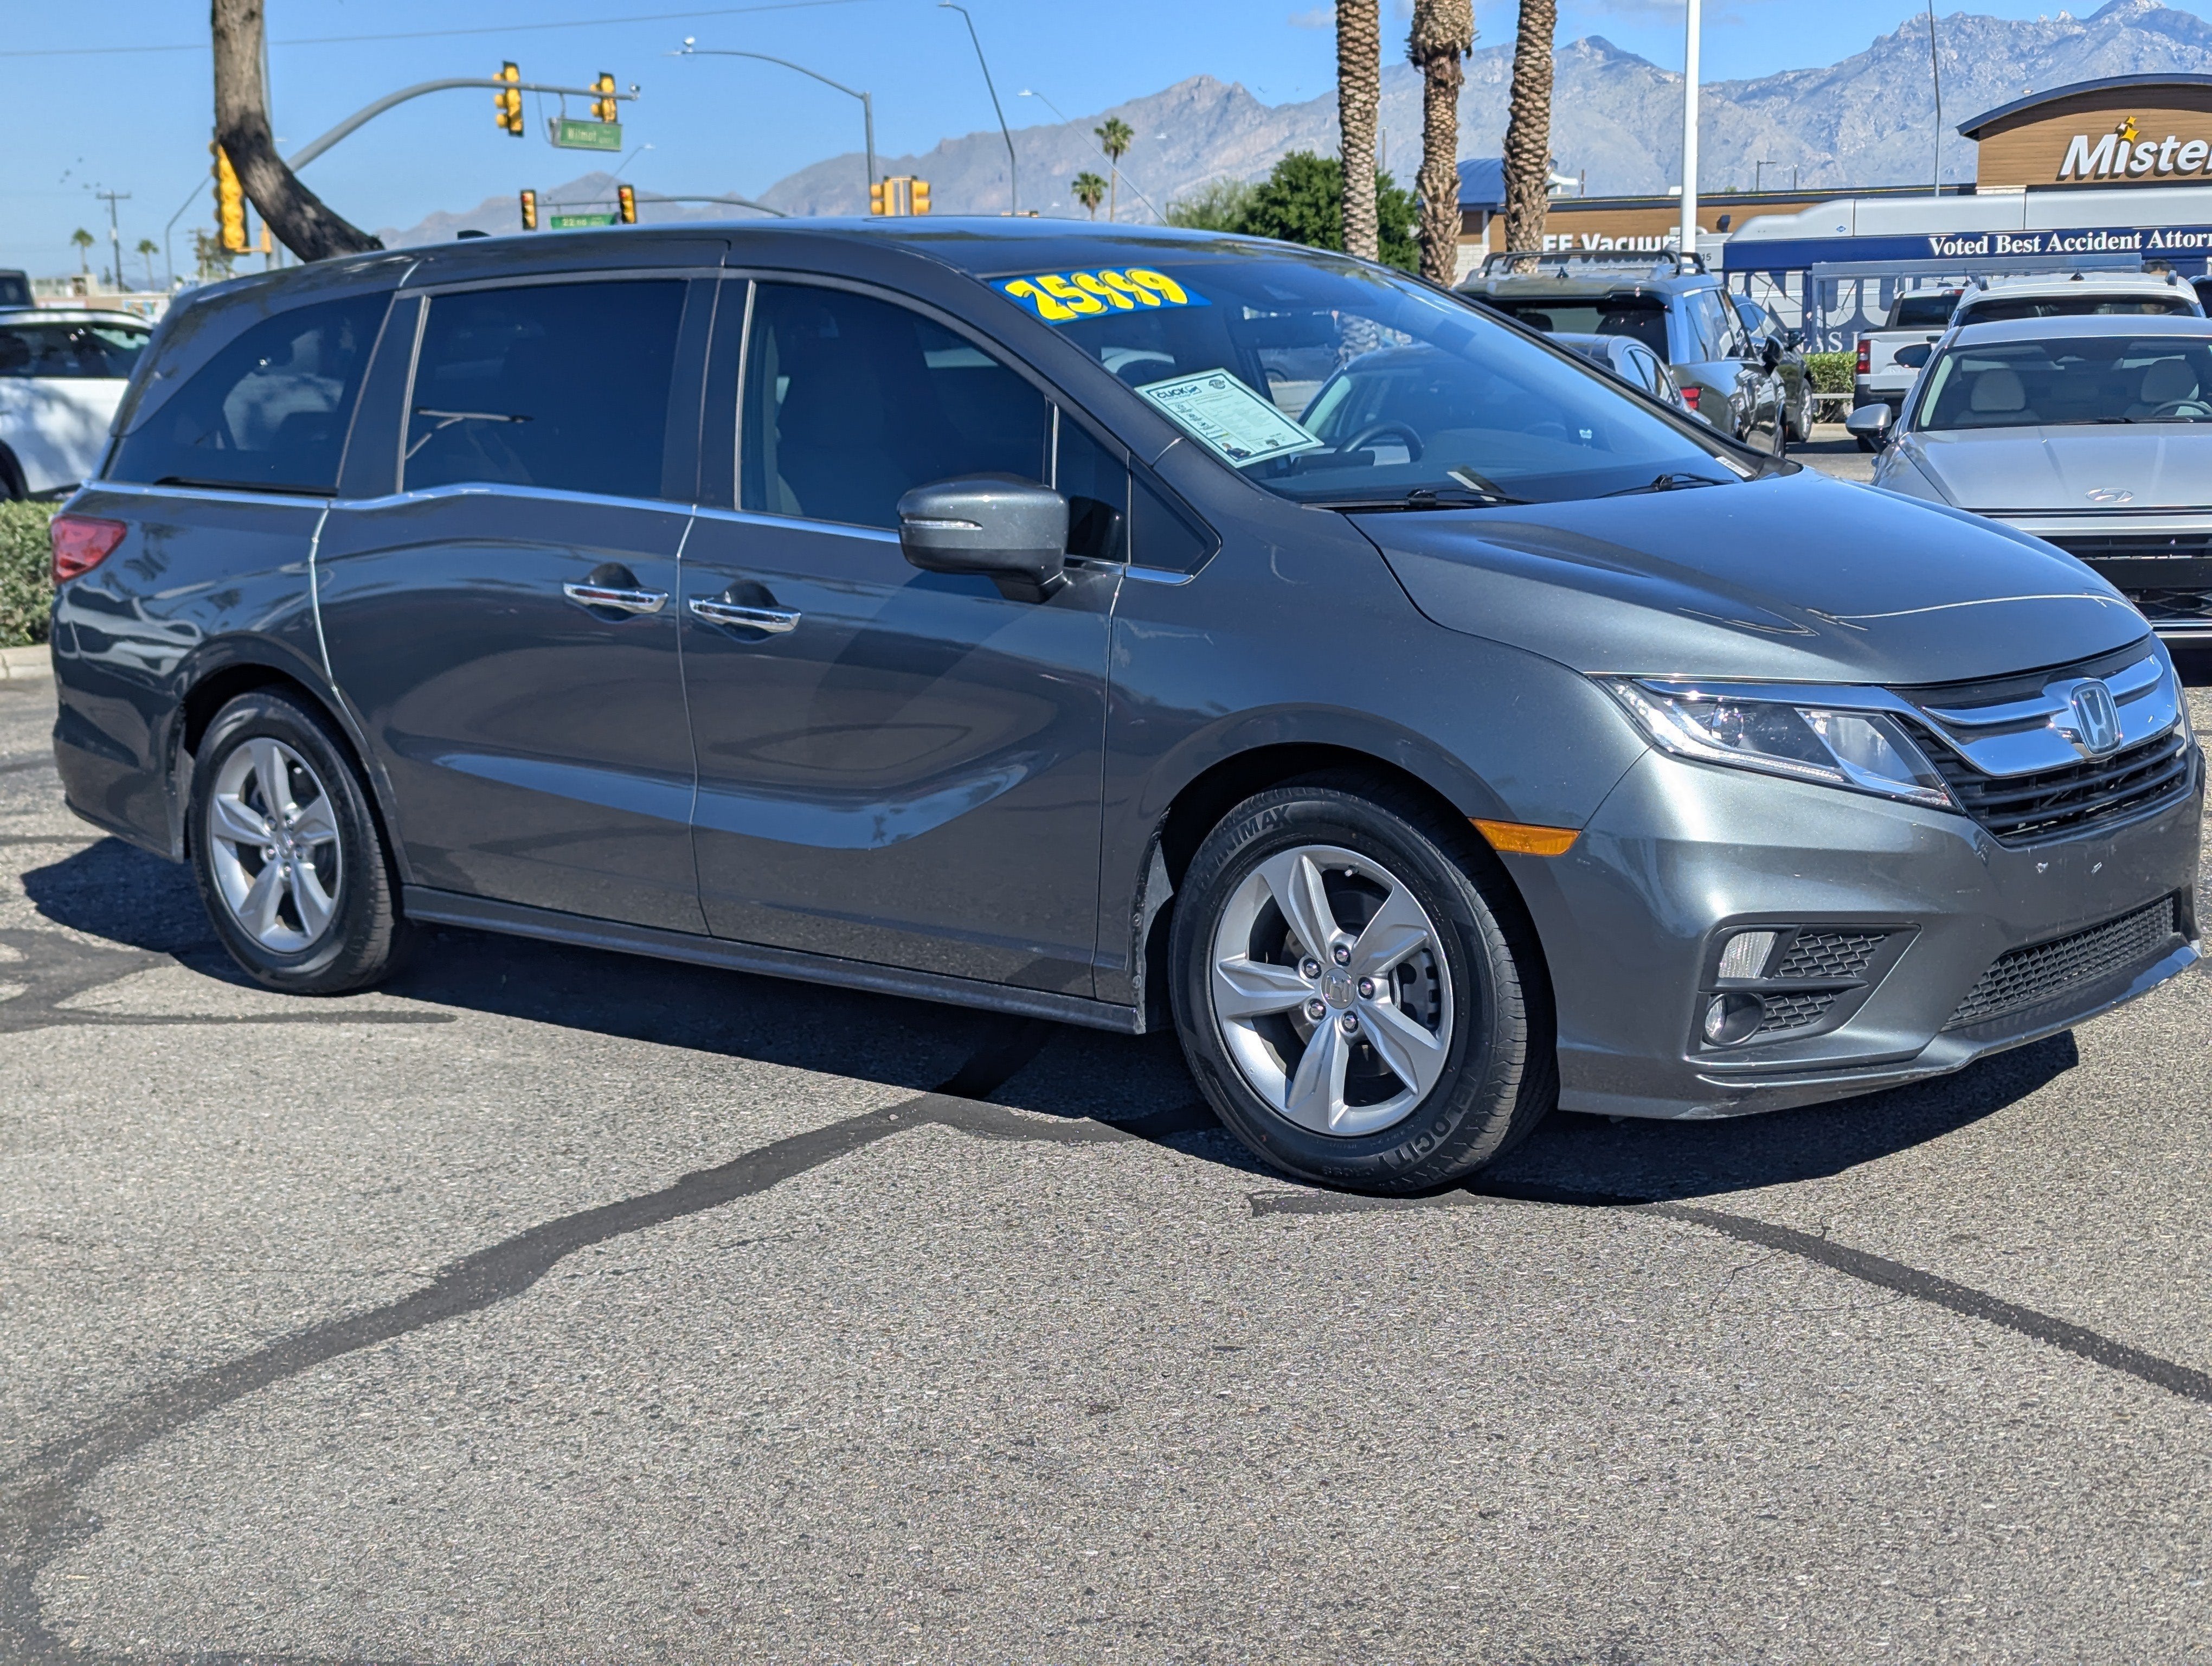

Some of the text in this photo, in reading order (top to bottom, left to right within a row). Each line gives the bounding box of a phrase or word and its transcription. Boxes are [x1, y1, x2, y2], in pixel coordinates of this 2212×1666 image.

[2059, 133, 2212, 176] Miste
[1928, 235, 1989, 257] Voted
[1995, 234, 2042, 254] Best
[2046, 232, 2143, 253] Accident
[1004, 269, 1189, 321] 25999
